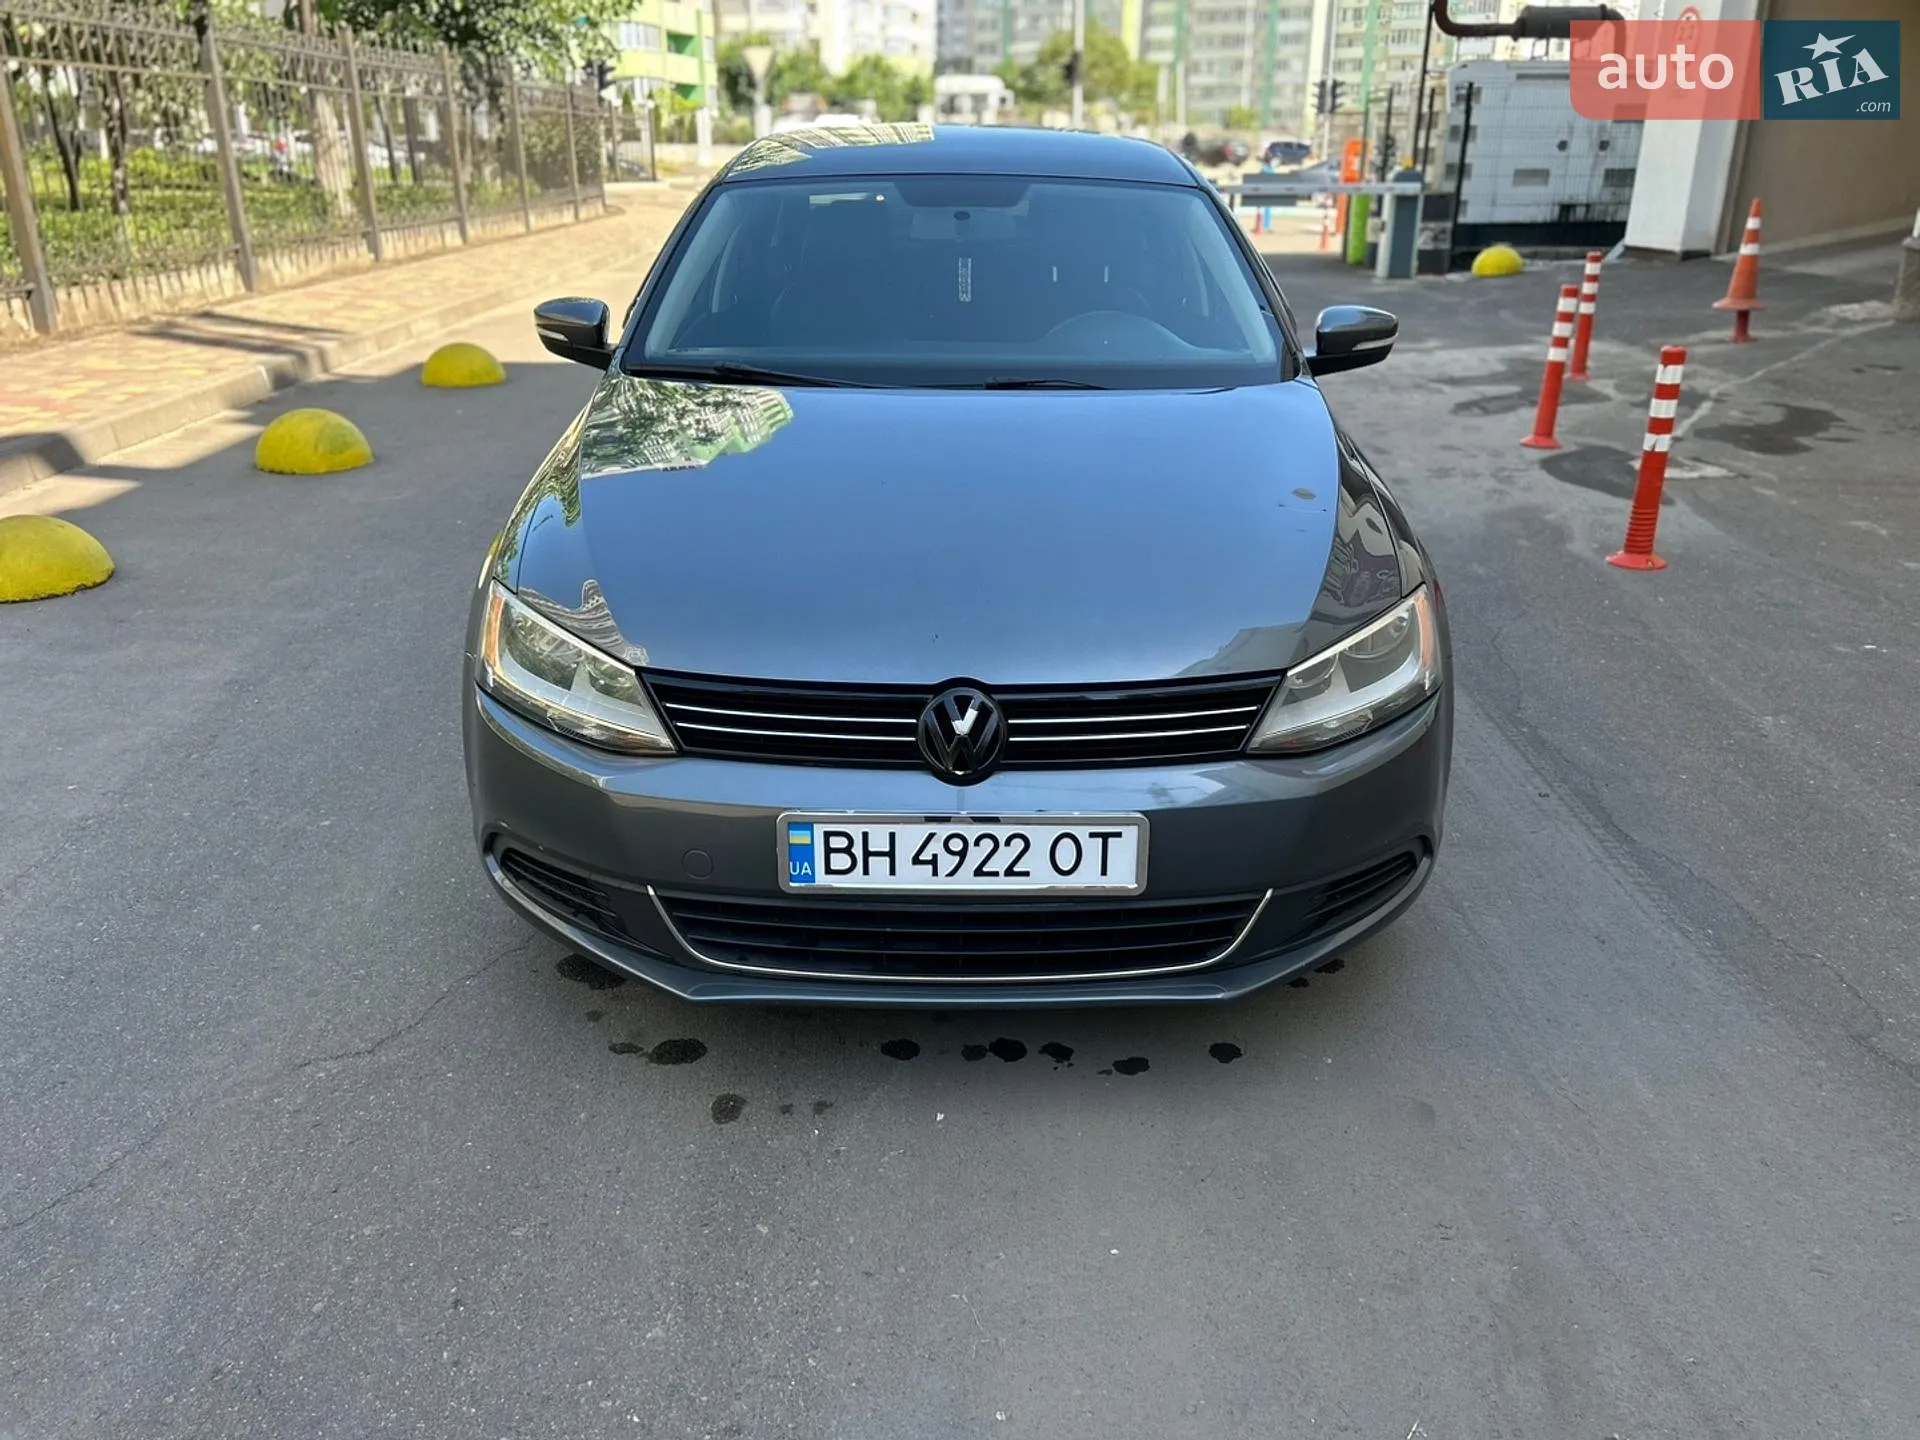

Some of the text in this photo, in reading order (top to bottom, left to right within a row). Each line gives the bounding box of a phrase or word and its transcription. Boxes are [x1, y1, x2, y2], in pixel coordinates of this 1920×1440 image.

[789, 861, 812, 876] UA
[822, 830, 1123, 877] BH 4922 OT
